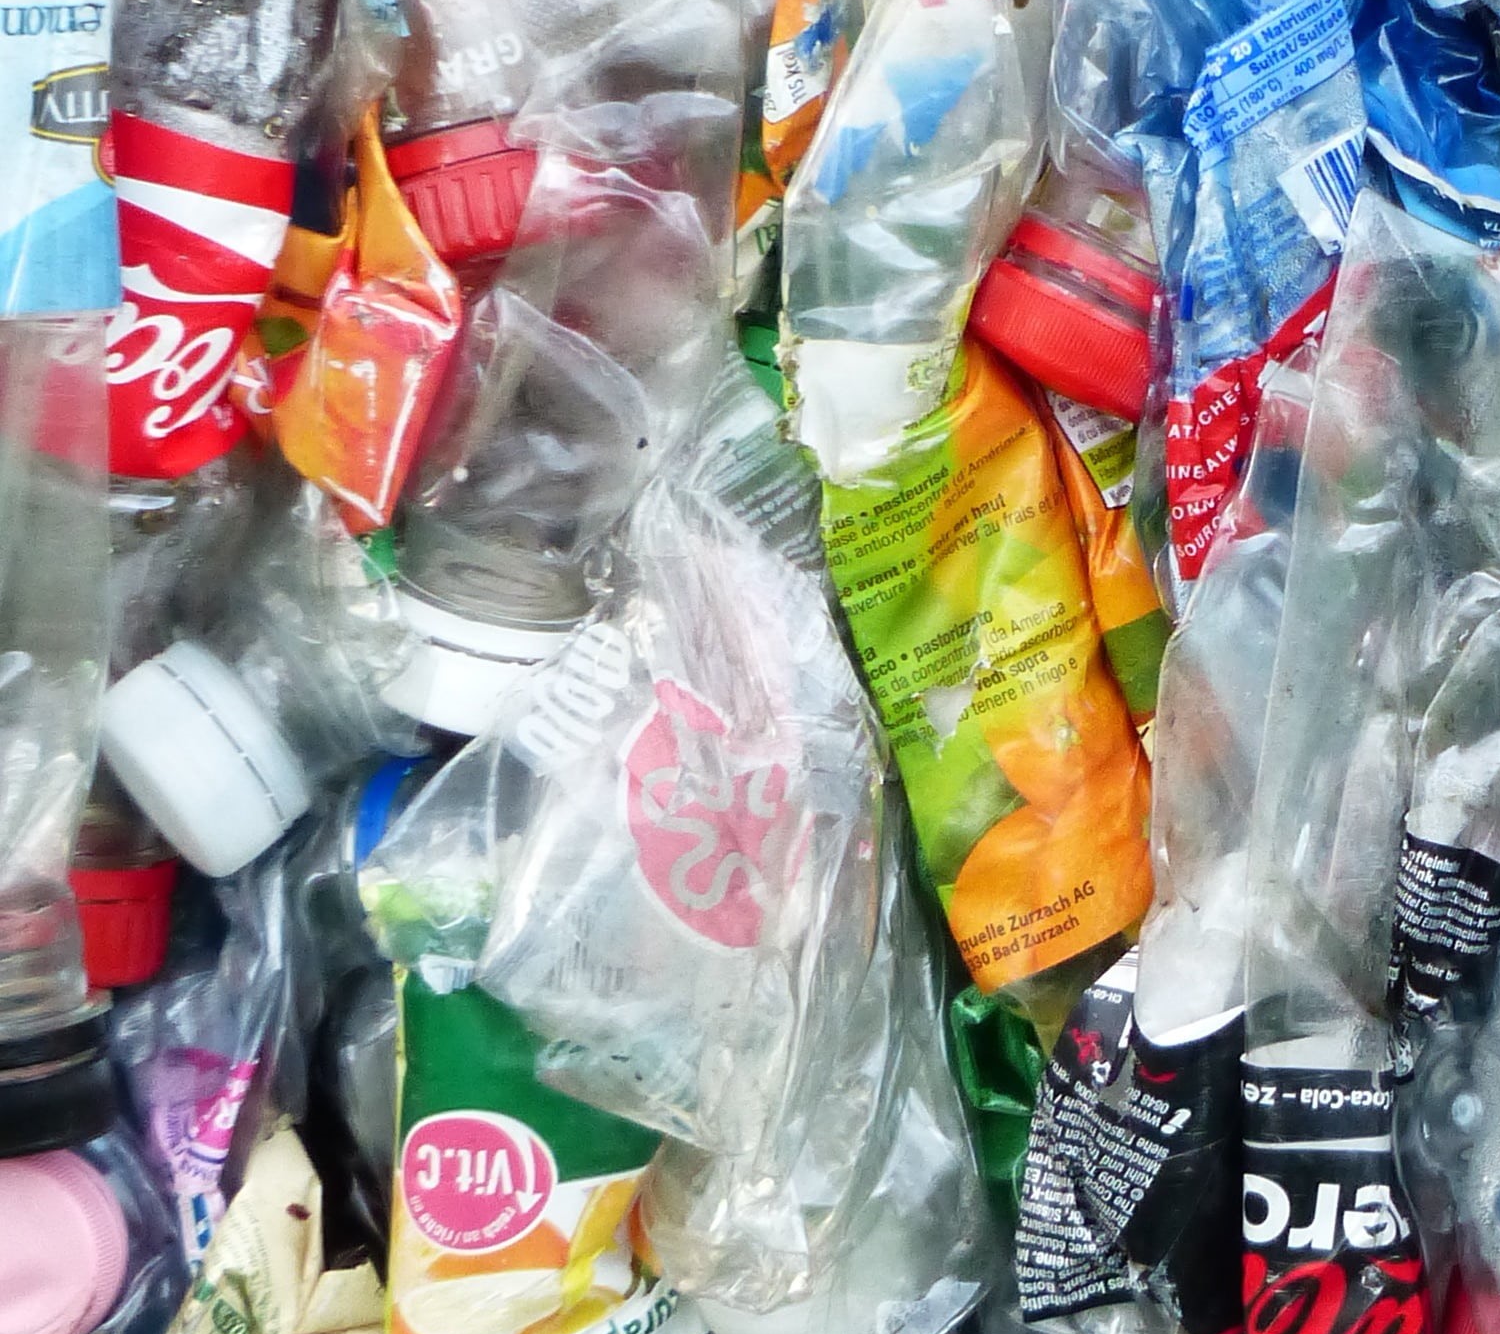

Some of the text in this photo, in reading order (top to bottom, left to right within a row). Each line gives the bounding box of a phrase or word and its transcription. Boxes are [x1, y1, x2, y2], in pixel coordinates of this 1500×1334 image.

[1229, 41, 1253, 63] 20
[1292, 58, 1317, 78] 400
[873, 465, 951, 517] pasteurisé
[855, 478, 977, 559] antioxydant acide
[862, 519, 880, 538] de
[983, 519, 1001, 539] au
[1002, 507, 1036, 530] frais
[857, 492, 1007, 592] avant le voir en haut
[1011, 600, 1067, 636] America
[1008, 648, 1049, 678] sopra
[972, 685, 1018, 715] tenere
[1020, 681, 1035, 696] in
[1036, 663, 1068, 691] frigo
[1007, 894, 1072, 933] Zurzach
[1073, 879, 1096, 906] AG
[991, 939, 1021, 962] Bad
[1020, 913, 1081, 948] Zurzach
[1138, 1135, 1171, 1159] siehe
[1098, 1168, 1131, 1194] 2009
[1099, 1150, 1155, 1189] Kühl und
[1114, 1193, 1136, 1215] The
[481, 1205, 517, 1241] reich
